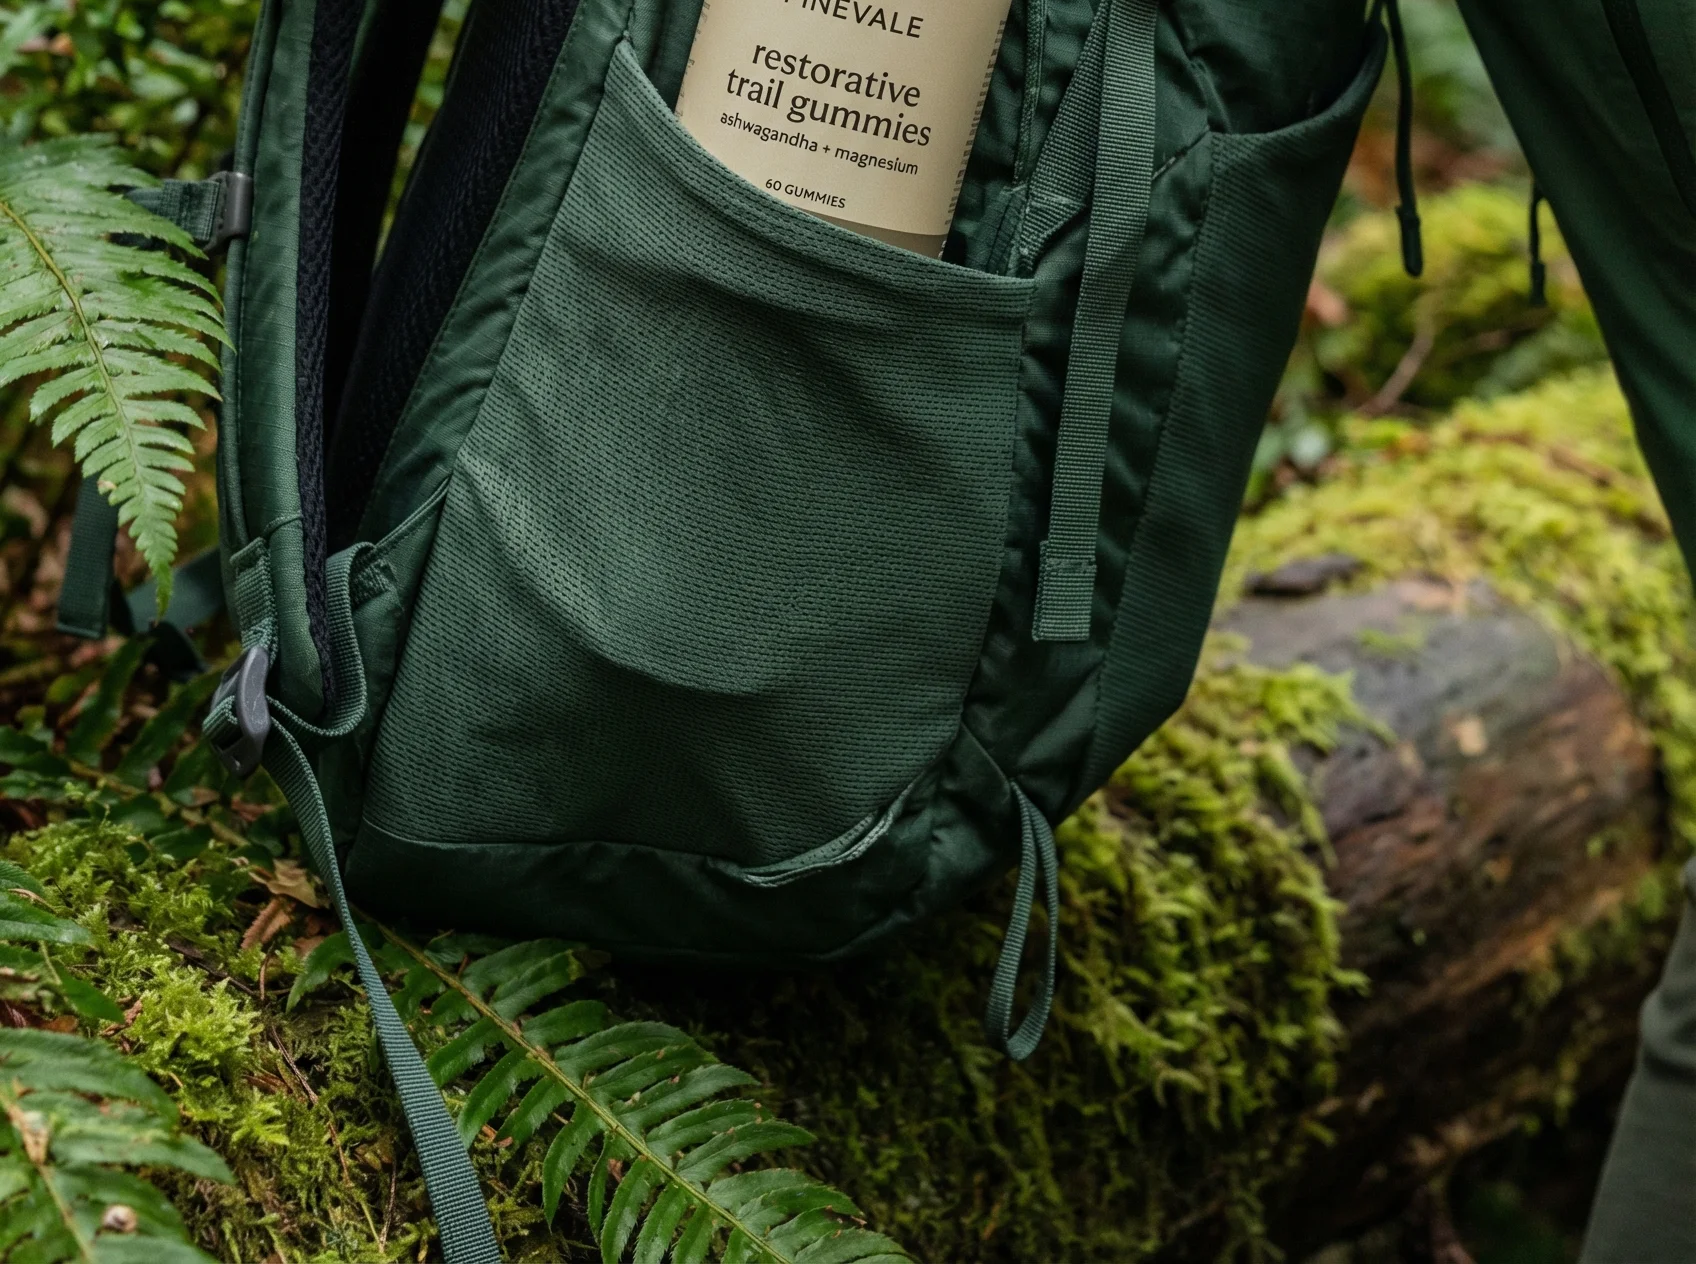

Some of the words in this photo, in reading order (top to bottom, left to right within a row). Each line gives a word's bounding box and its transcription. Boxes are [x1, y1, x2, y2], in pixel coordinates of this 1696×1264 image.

[726, 68, 785, 110] trail
[786, 95, 932, 148] gummies
[752, 44, 921, 109] restorative
[719, 112, 819, 154] ashwagandha
[822, 144, 832, 154] +
[834, 147, 920, 176] magnesium
[765, 178, 782, 192] 60
[784, 183, 847, 209] GUMMIES
